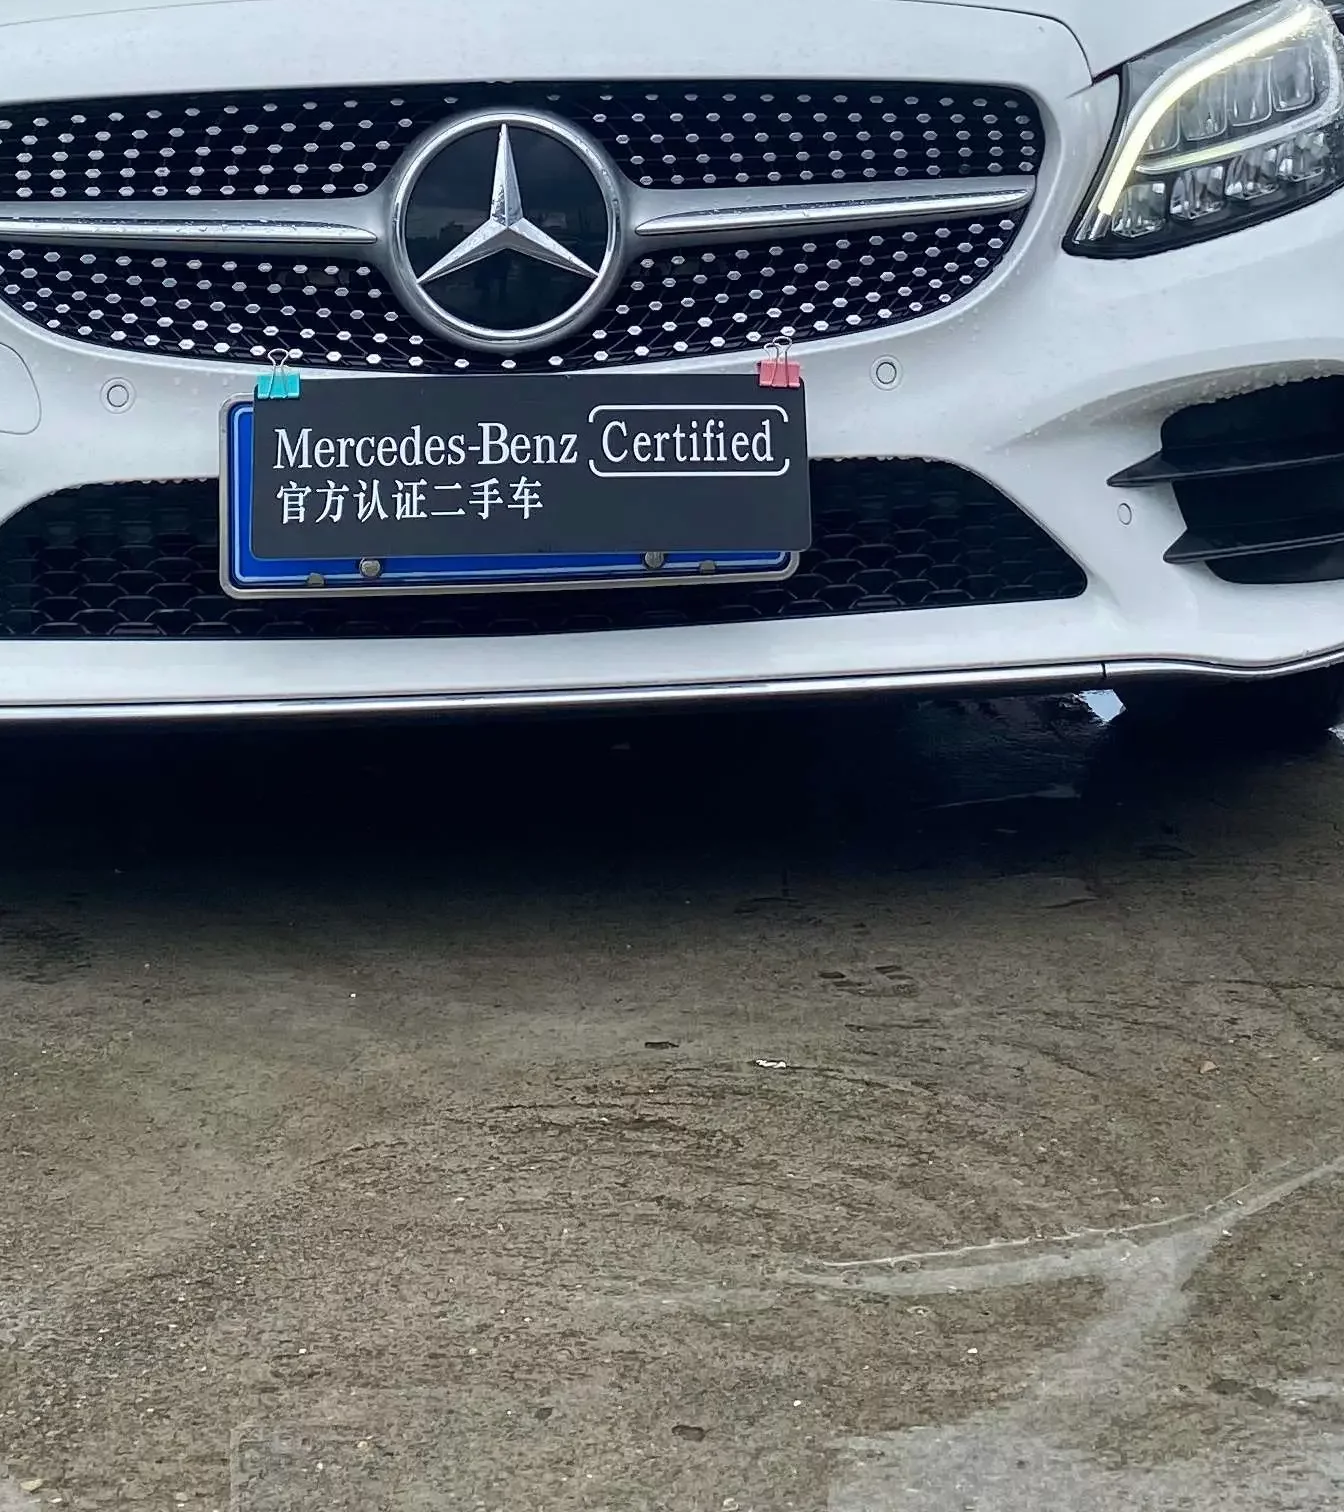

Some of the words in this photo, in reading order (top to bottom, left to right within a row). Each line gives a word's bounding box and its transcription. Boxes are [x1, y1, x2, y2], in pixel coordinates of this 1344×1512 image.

[272, 422, 578, 469] Mercedes-Benz
[602, 419, 774, 462] Certified
[276, 475, 543, 524] 官方认证二手车
